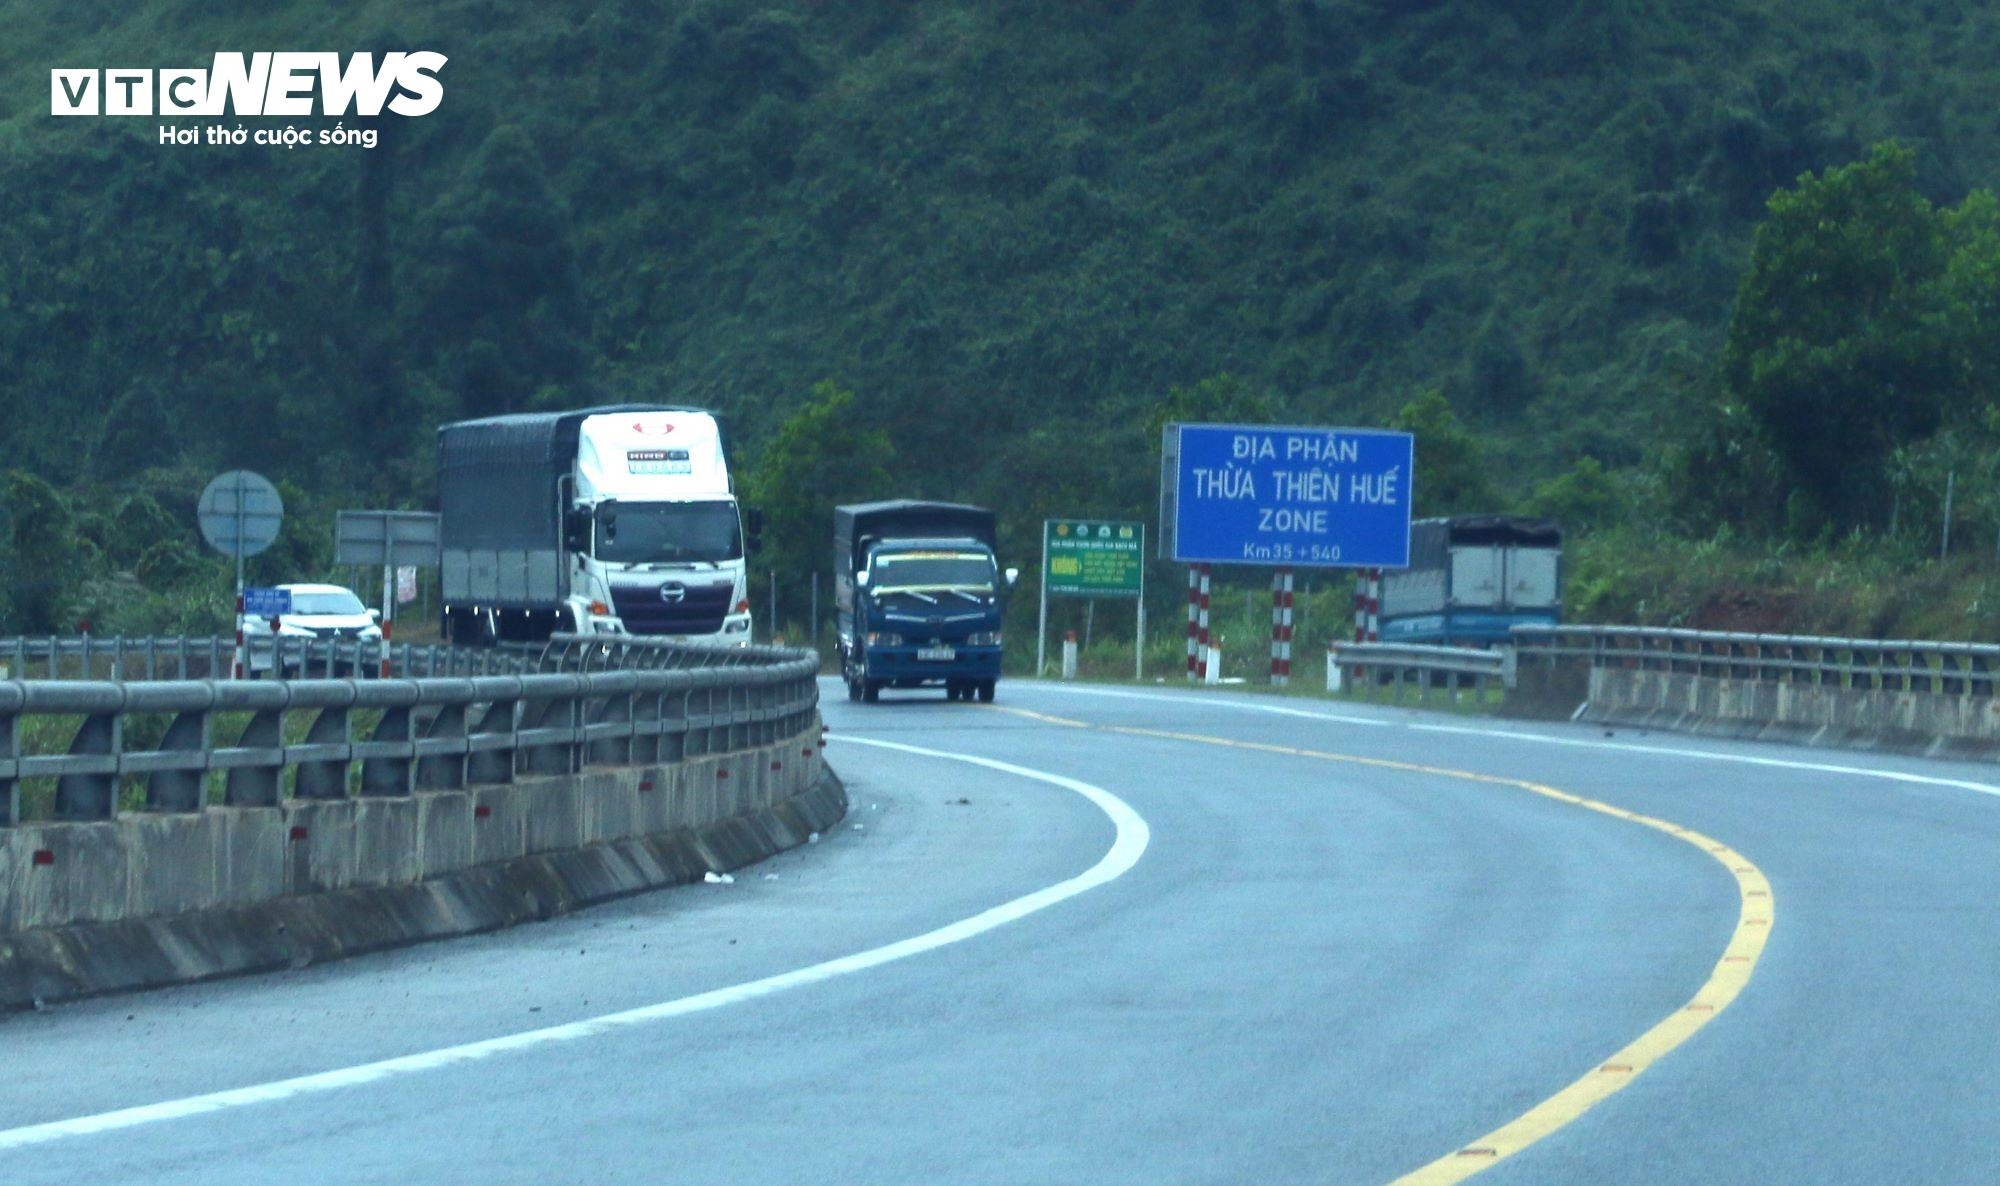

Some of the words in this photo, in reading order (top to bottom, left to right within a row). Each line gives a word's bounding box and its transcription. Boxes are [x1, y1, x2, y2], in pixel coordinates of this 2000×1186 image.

[1233, 435, 1276, 464] ĐỊA
[1287, 432, 1357, 467] PHẬN
[1193, 461, 1256, 499] THỪA
[1272, 467, 1340, 502] THIÊN
[1350, 464, 1400, 505] HUẾ
[1258, 508, 1328, 533] ZONE
